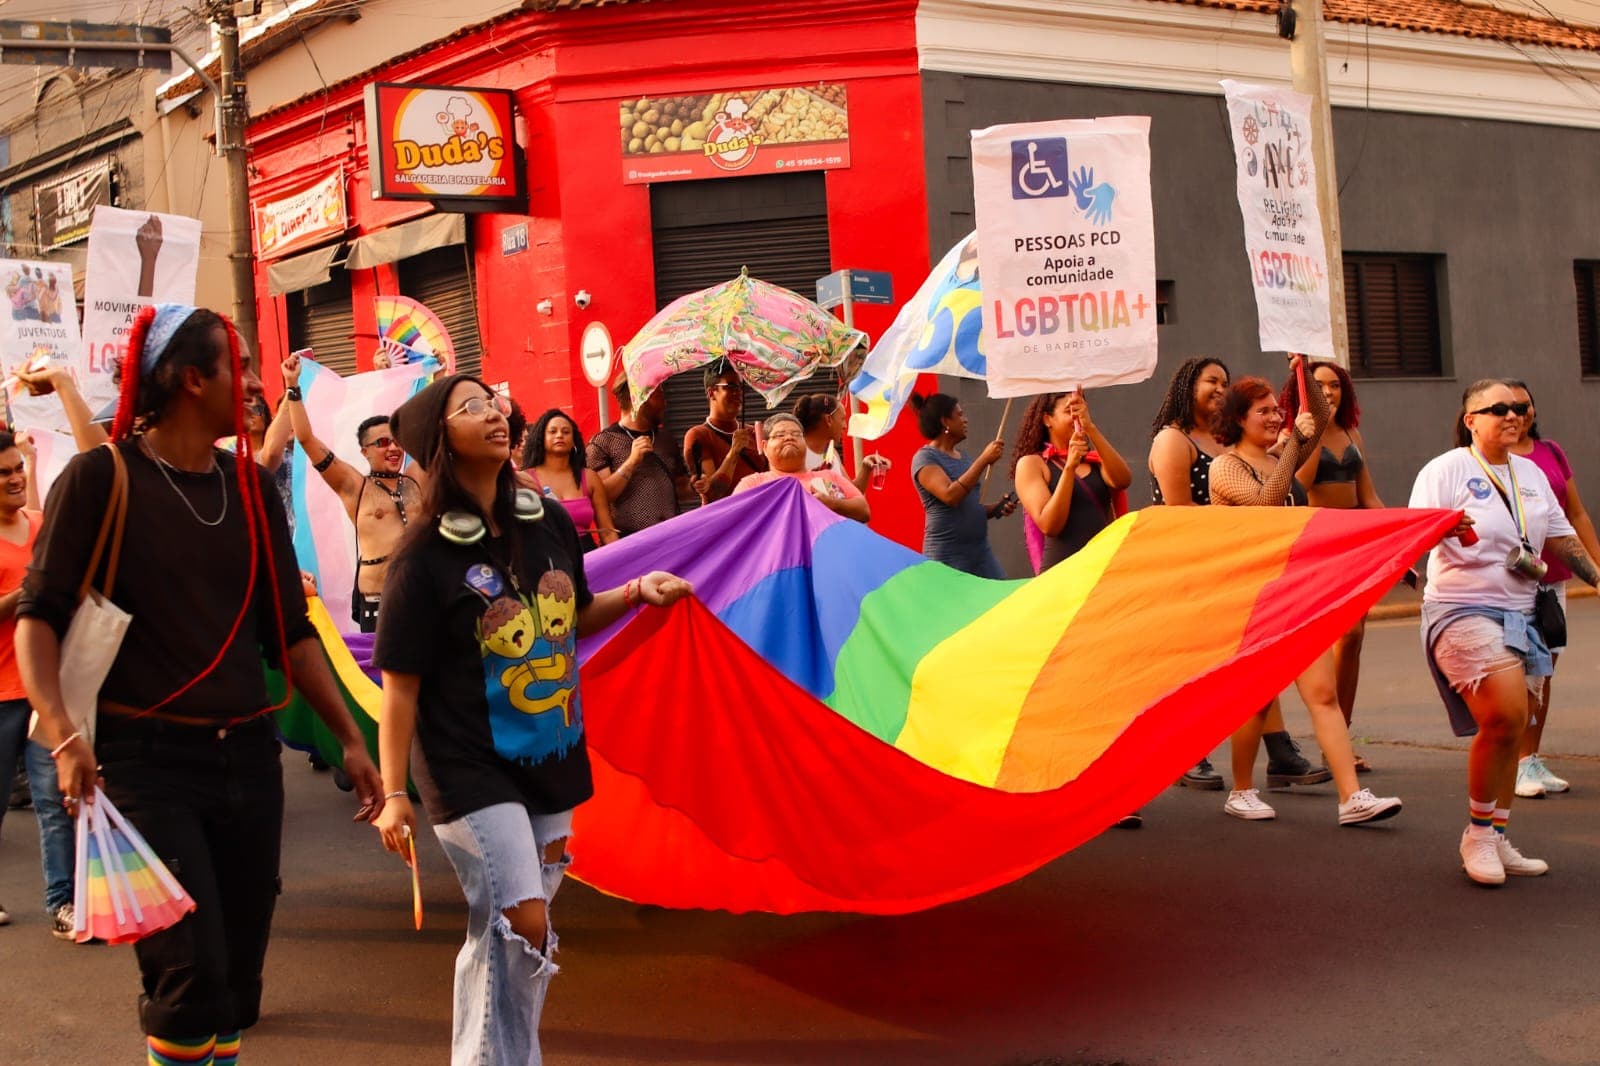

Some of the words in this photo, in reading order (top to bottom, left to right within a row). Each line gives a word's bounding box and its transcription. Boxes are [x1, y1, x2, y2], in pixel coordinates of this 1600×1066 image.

[393, 131, 504, 170] Duda's
[703, 134, 762, 157] Duda's
[394, 173, 447, 185] SALGADERIA
[449, 175, 456, 184] E
[457, 175, 506, 186] PASTELARIA
[502, 231, 516, 252] Rua
[516, 228, 526, 249] 18
[1014, 233, 1086, 253] PESSOAS
[1091, 230, 1121, 247] PCD
[1044, 255, 1084, 272] Apoia
[1088, 256, 1096, 266] a
[1026, 267, 1114, 287] comunidade
[94, 300, 143, 314] MOVIMEN
[994, 289, 1152, 339] LGBTQIA+
[18, 327, 68, 339] JUVENTUDE
[1023, 344, 1039, 354] DE
[1045, 338, 1111, 352] BARRETOS
